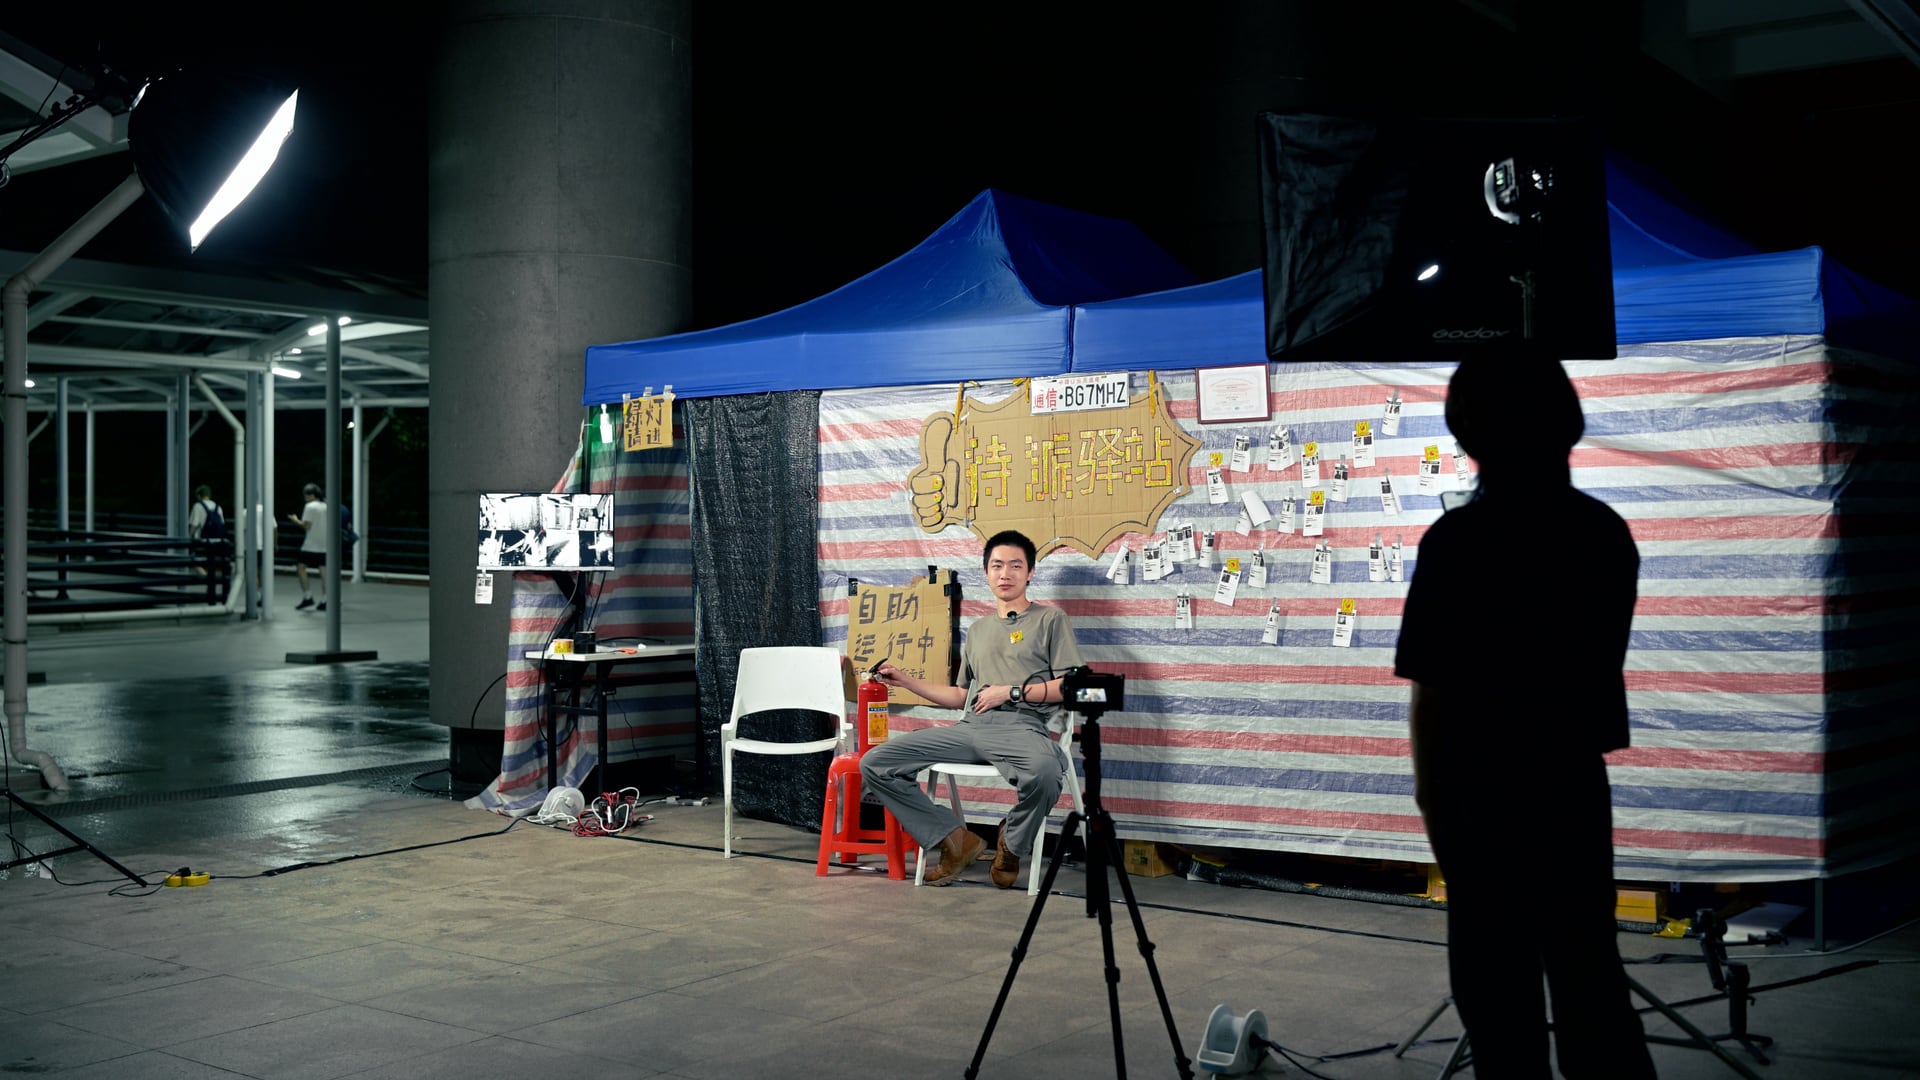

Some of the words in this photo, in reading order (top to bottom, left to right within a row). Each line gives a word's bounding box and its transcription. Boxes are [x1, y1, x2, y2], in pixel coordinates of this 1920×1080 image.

[858, 589, 919, 624] 自助
[853, 626, 935, 664] 运行中
